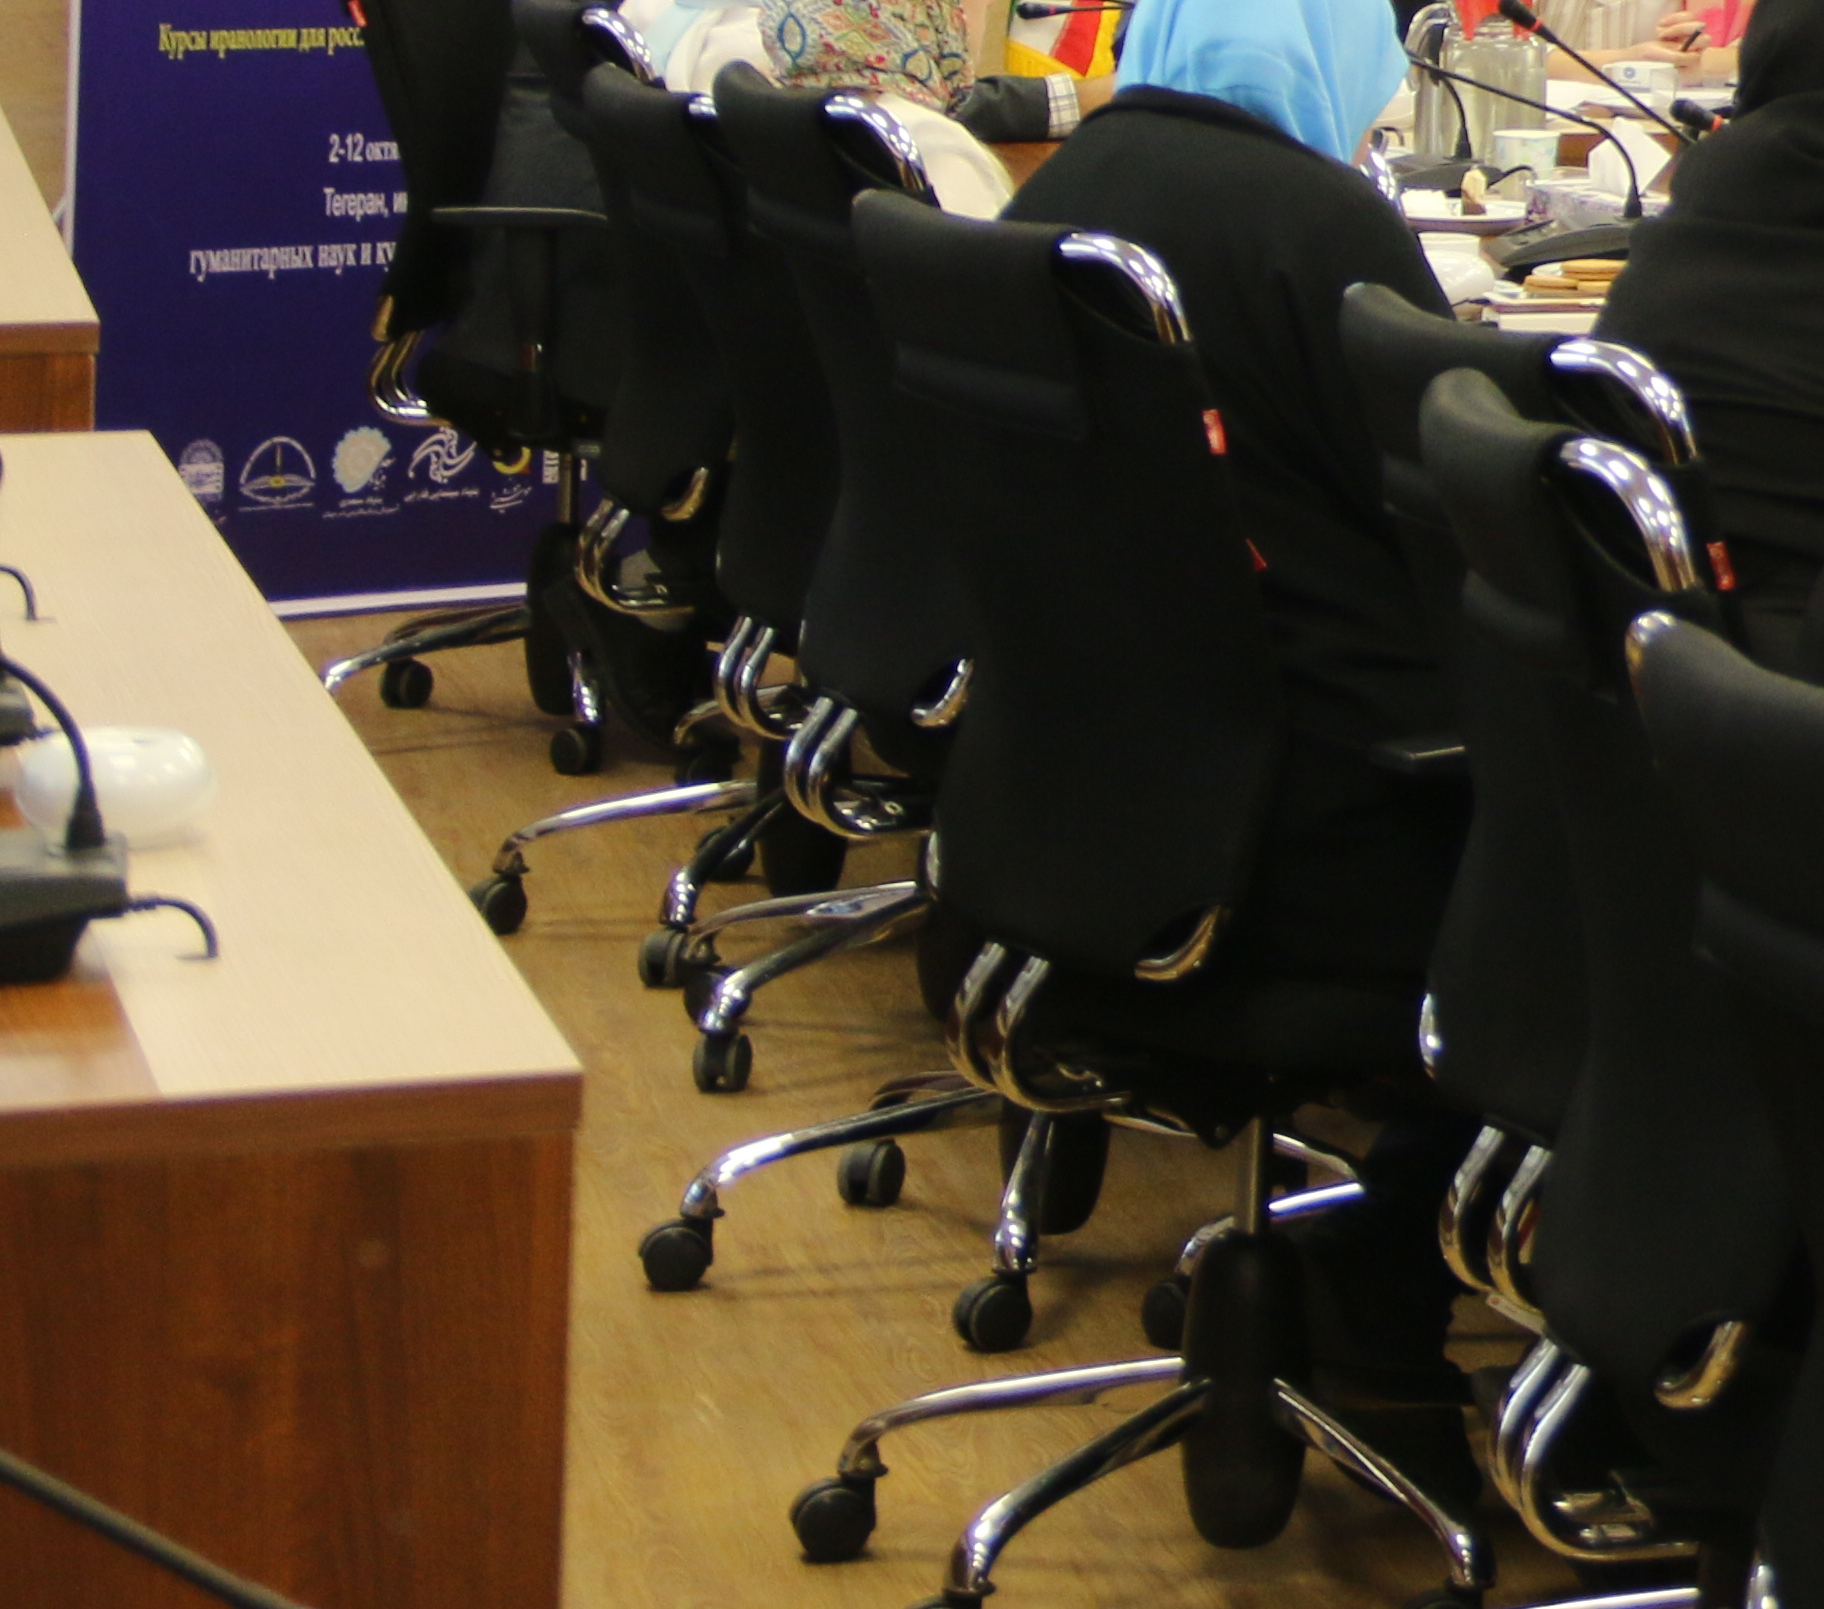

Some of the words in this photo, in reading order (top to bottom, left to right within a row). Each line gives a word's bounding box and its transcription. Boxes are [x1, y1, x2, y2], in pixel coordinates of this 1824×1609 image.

[158, 23, 207, 60] Курсы
[299, 27, 326, 52] для
[329, 133, 364, 164] 2-12
[323, 187, 389, 222] Тегеран,
[190, 246, 314, 283] гуманитарных
[317, 243, 357, 276] наук
[360, 242, 372, 266] и
